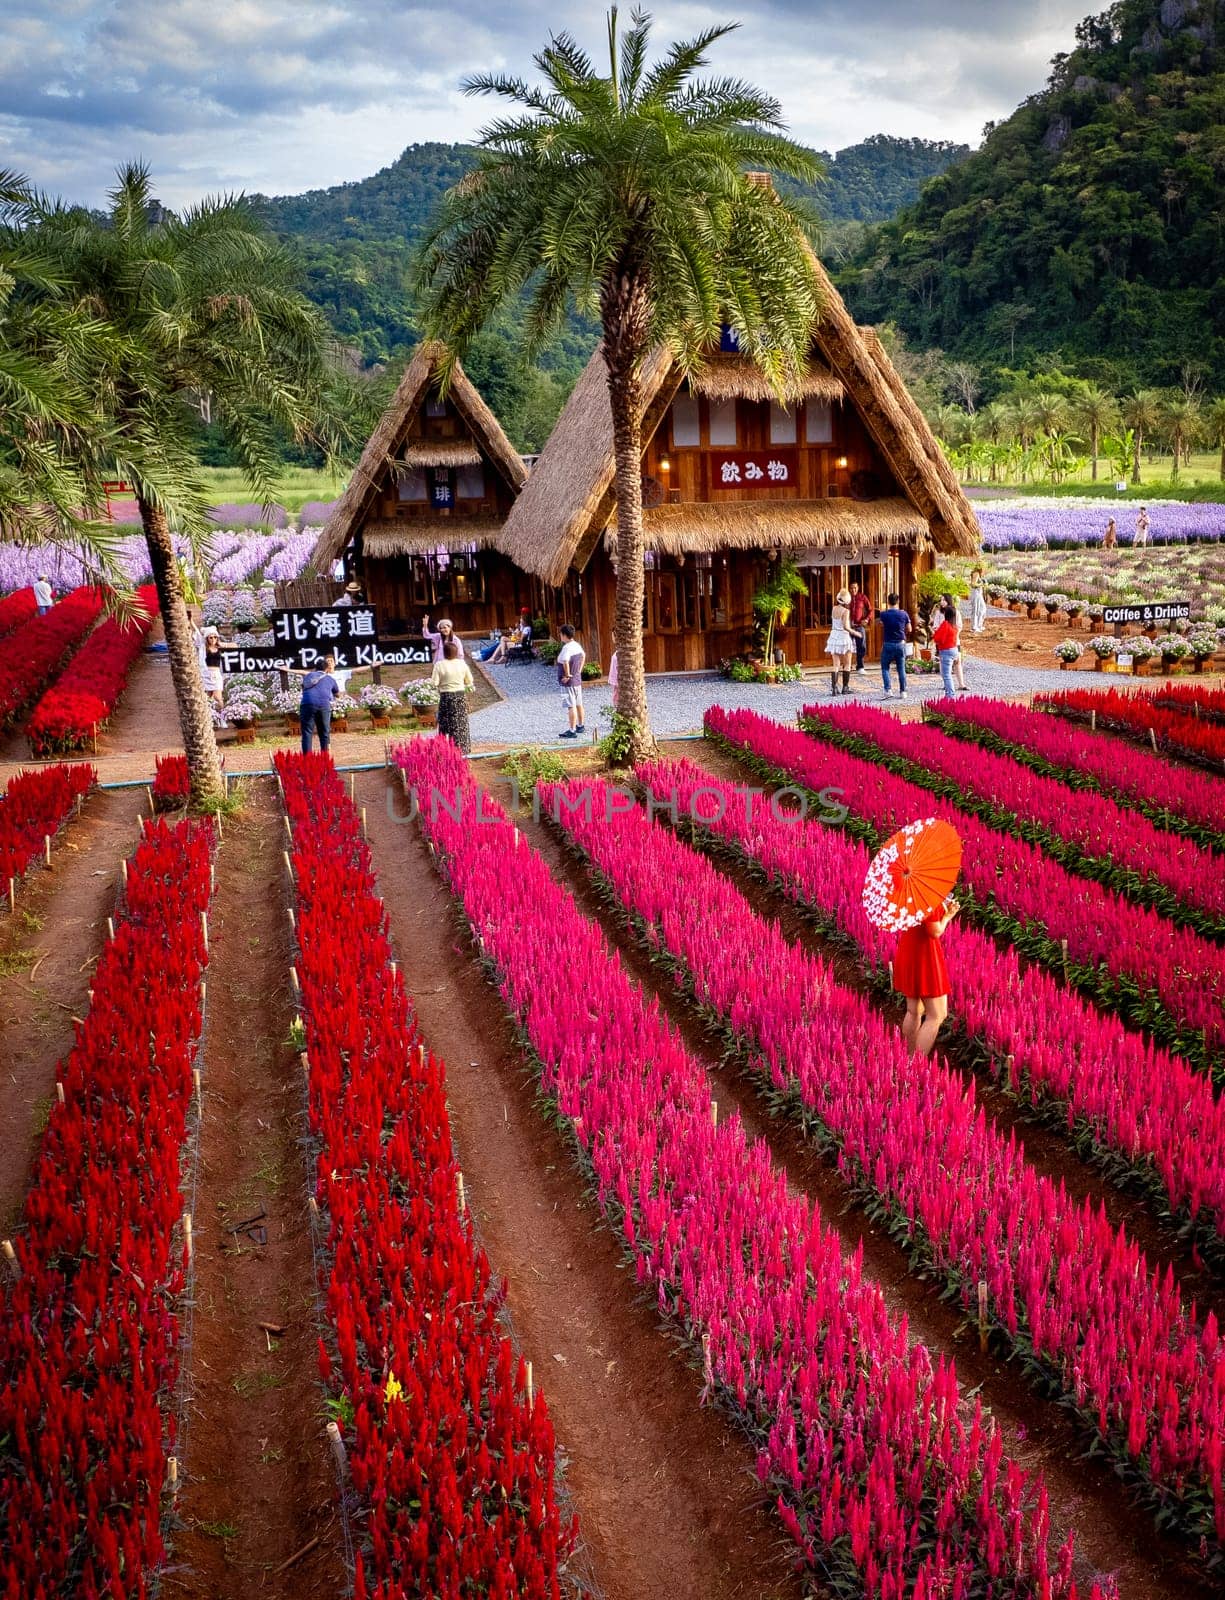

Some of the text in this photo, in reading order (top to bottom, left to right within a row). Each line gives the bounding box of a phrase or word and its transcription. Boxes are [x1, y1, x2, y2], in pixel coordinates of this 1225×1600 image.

[721, 460, 788, 483] 飲み物
[276, 609, 375, 640] 北海道
[1143, 607, 1153, 619] &
[1155, 605, 1189, 619] Drinks
[221, 651, 294, 672] Flower
[356, 643, 431, 664] KhaoYai
